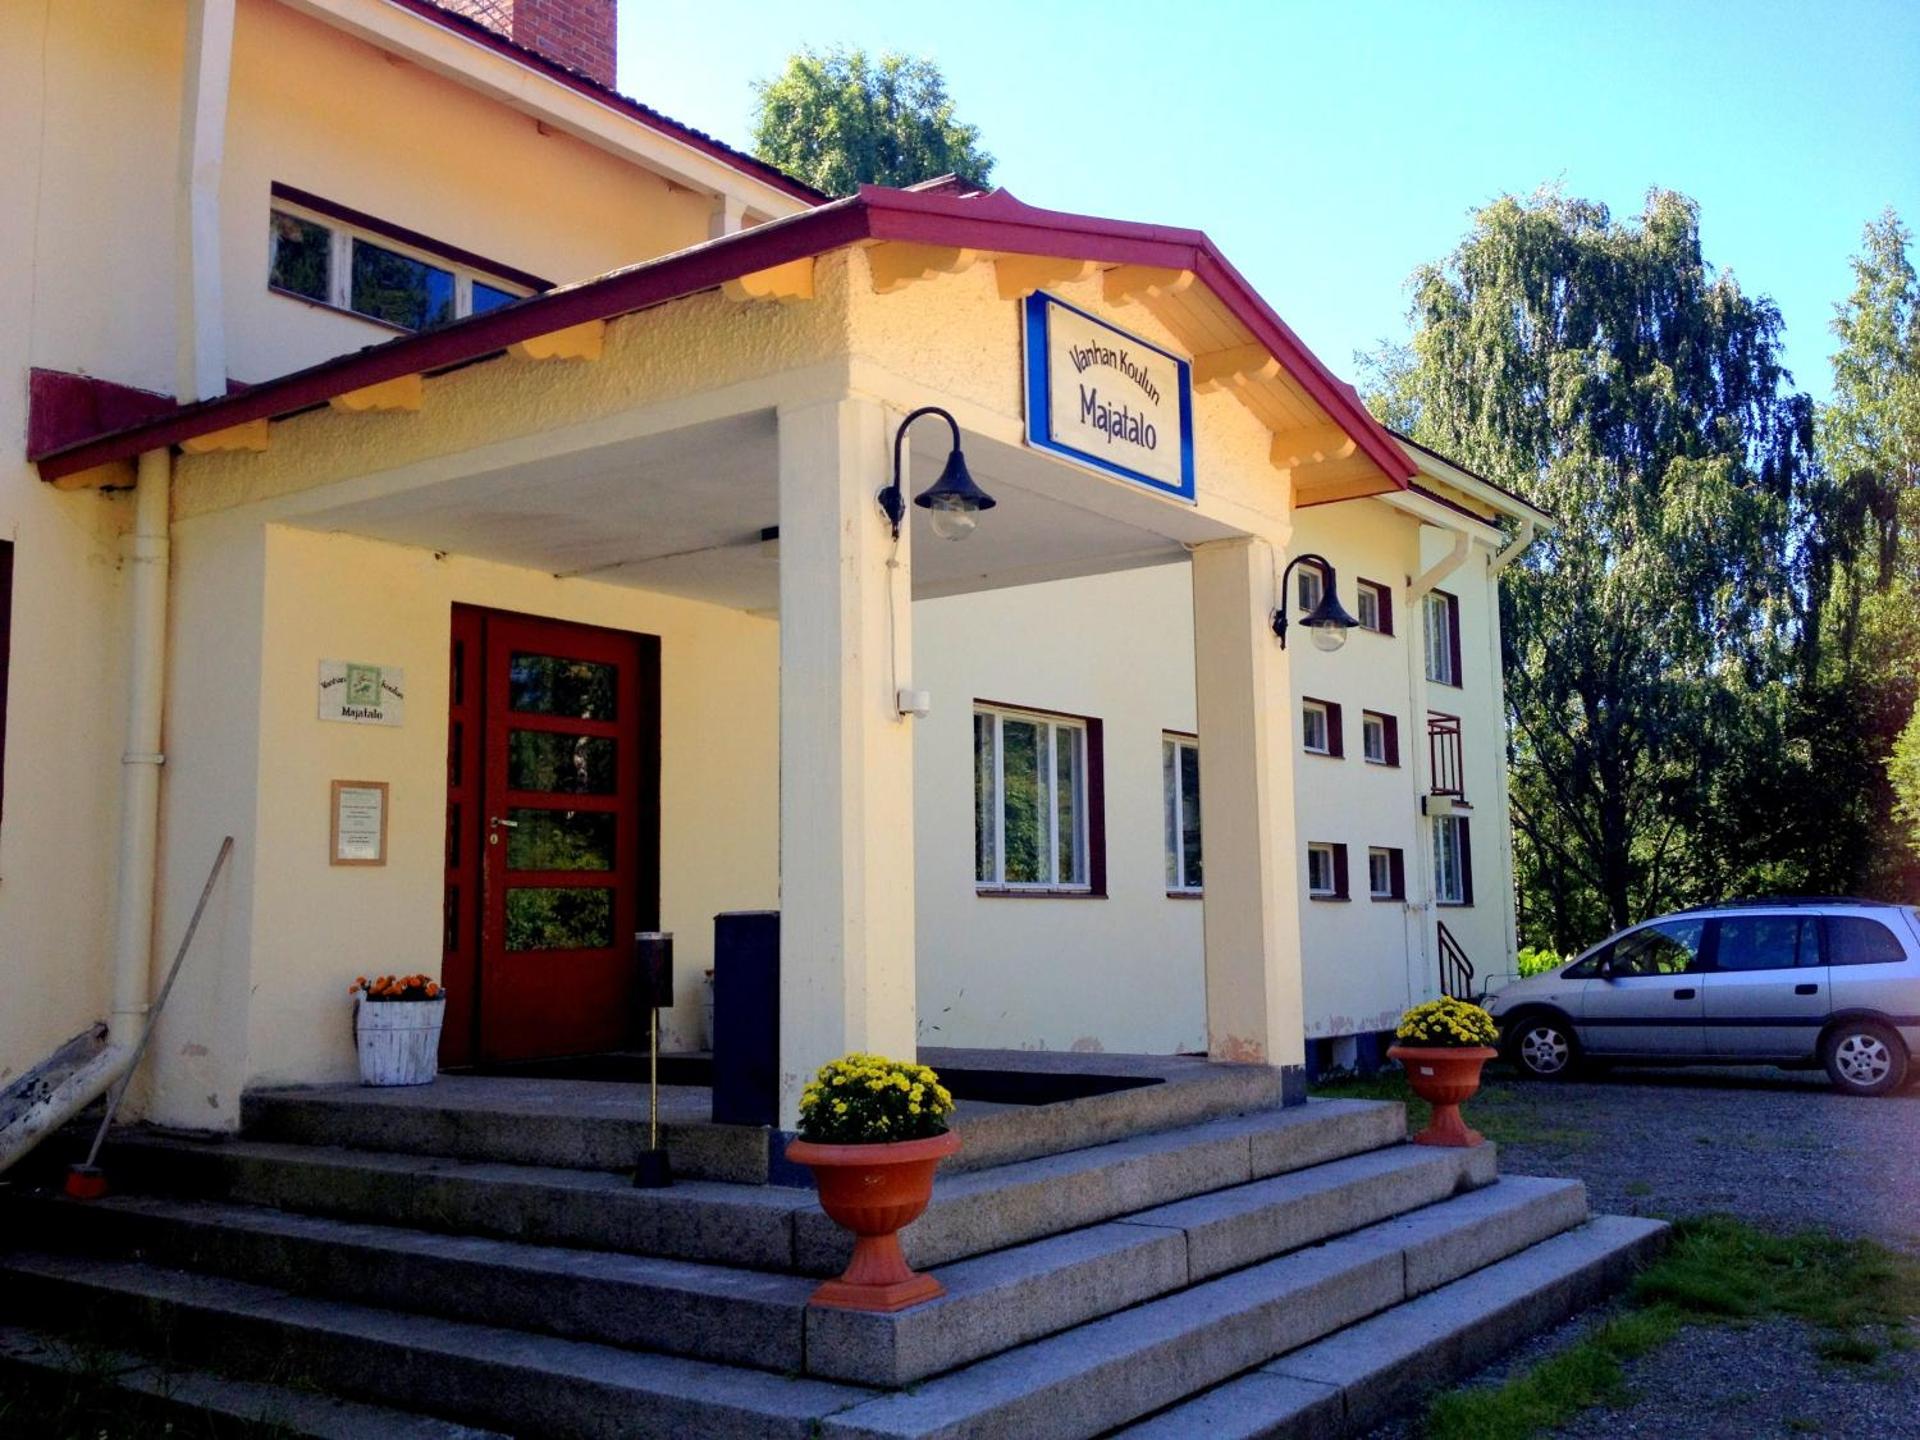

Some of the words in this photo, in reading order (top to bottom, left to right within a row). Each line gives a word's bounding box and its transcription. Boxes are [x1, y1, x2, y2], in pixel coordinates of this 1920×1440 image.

[1069, 339, 1117, 374] Vanhan
[1119, 350, 1160, 405] Koulun
[1079, 383, 1157, 450] Majatalo
